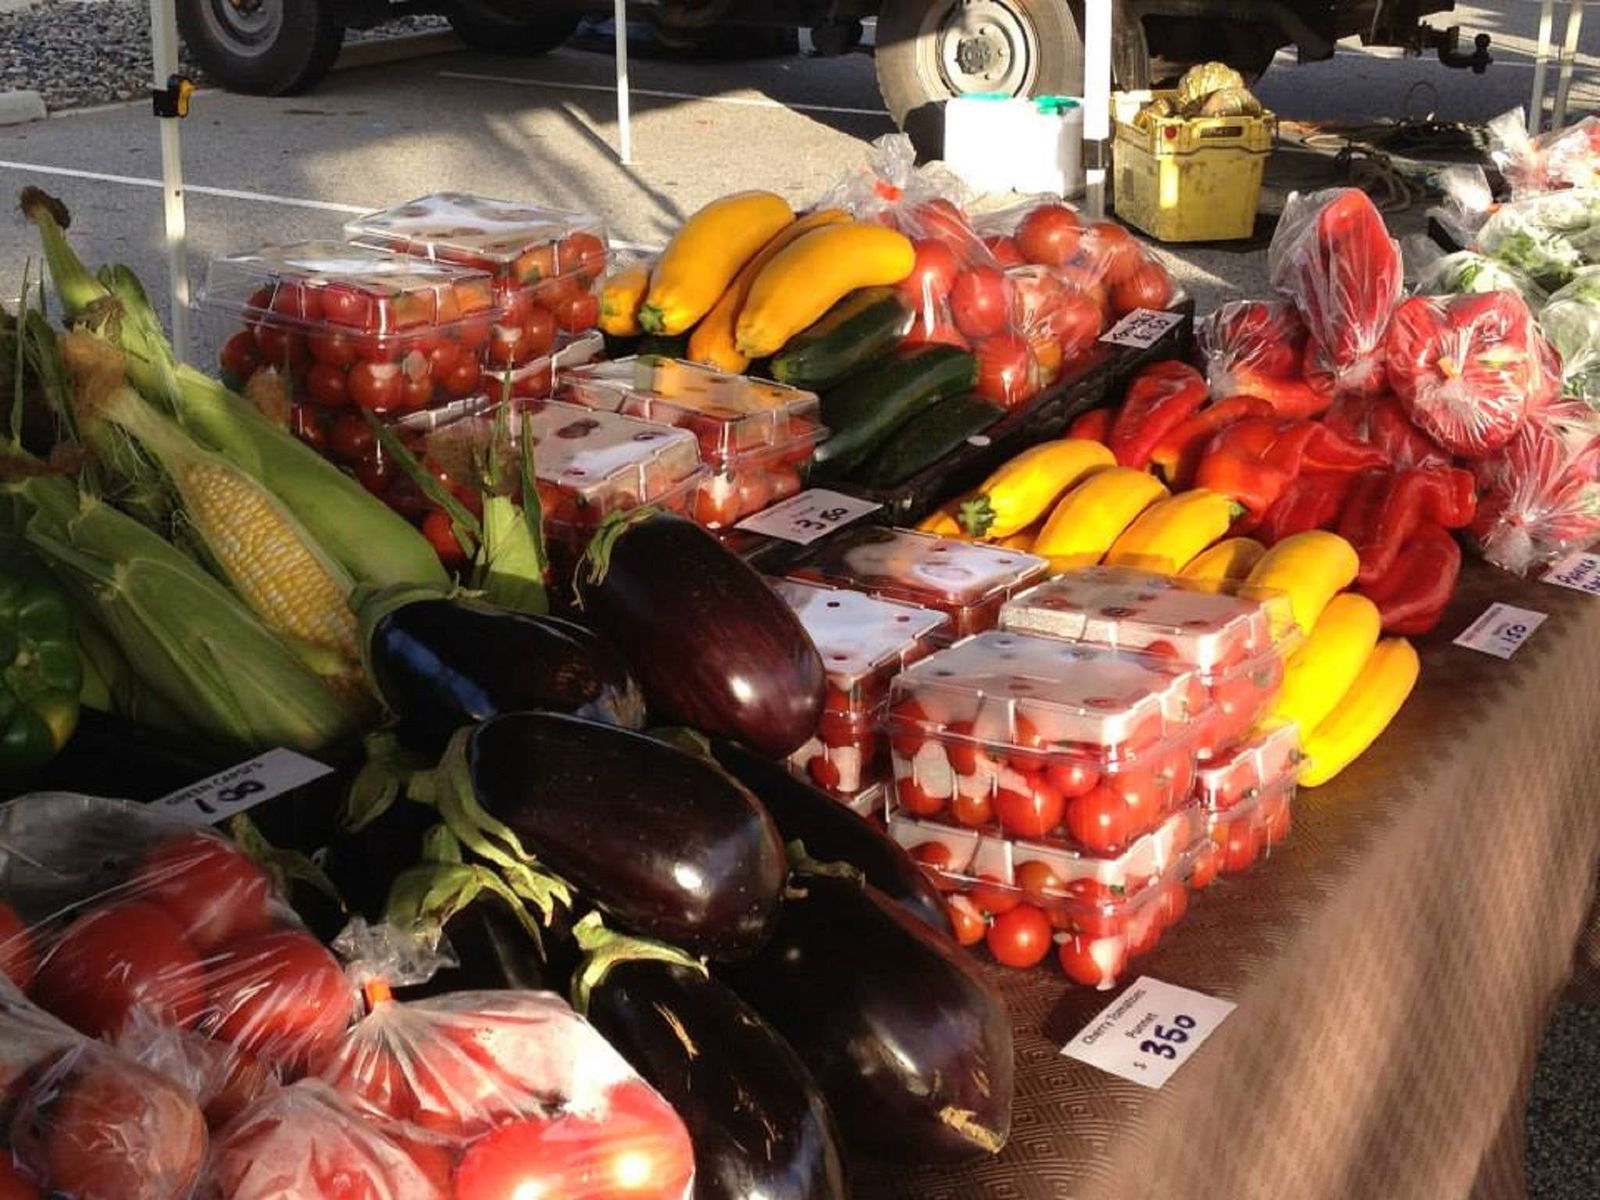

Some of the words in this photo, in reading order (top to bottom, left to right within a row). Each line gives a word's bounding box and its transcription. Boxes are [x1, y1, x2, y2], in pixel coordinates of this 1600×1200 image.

[1083, 1015, 1115, 1046] Cherry
[1112, 988, 1147, 1020] Tomatoes
[1124, 1012, 1159, 1039] Punnet
[1140, 1014, 1197, 1060] 350
